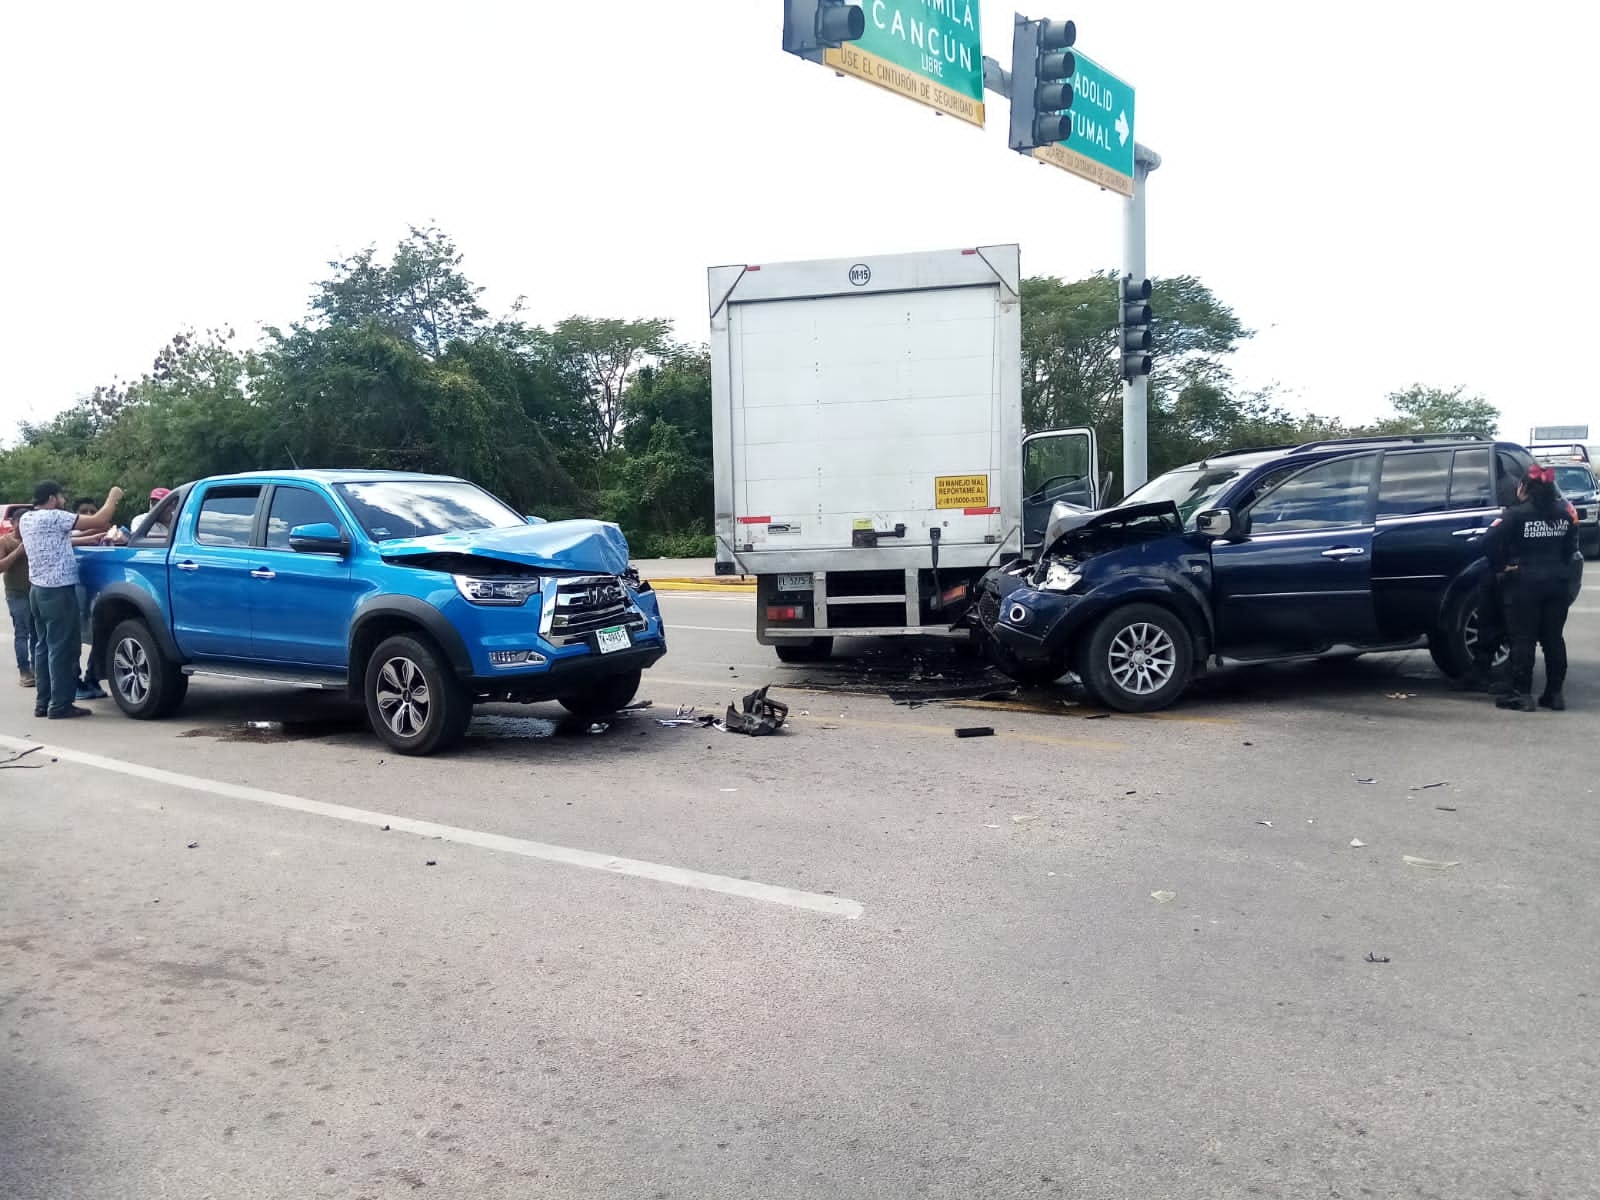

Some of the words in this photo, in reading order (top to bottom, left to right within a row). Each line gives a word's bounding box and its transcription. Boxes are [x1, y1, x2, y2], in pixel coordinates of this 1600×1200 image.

[872, 1, 972, 73] CANCÚN
[841, 47, 859, 69] USE
[862, 60, 873, 76] EL
[876, 63, 917, 94] CINTURÓN
[920, 82, 931, 98] DE
[934, 89, 974, 117] SEGURIDAD
[921, 55, 943, 78] LIBRE
[1066, 71, 1113, 112] ADOLID
[1066, 109, 1112, 151] TUMAL
[851, 270, 868, 281] M-15
